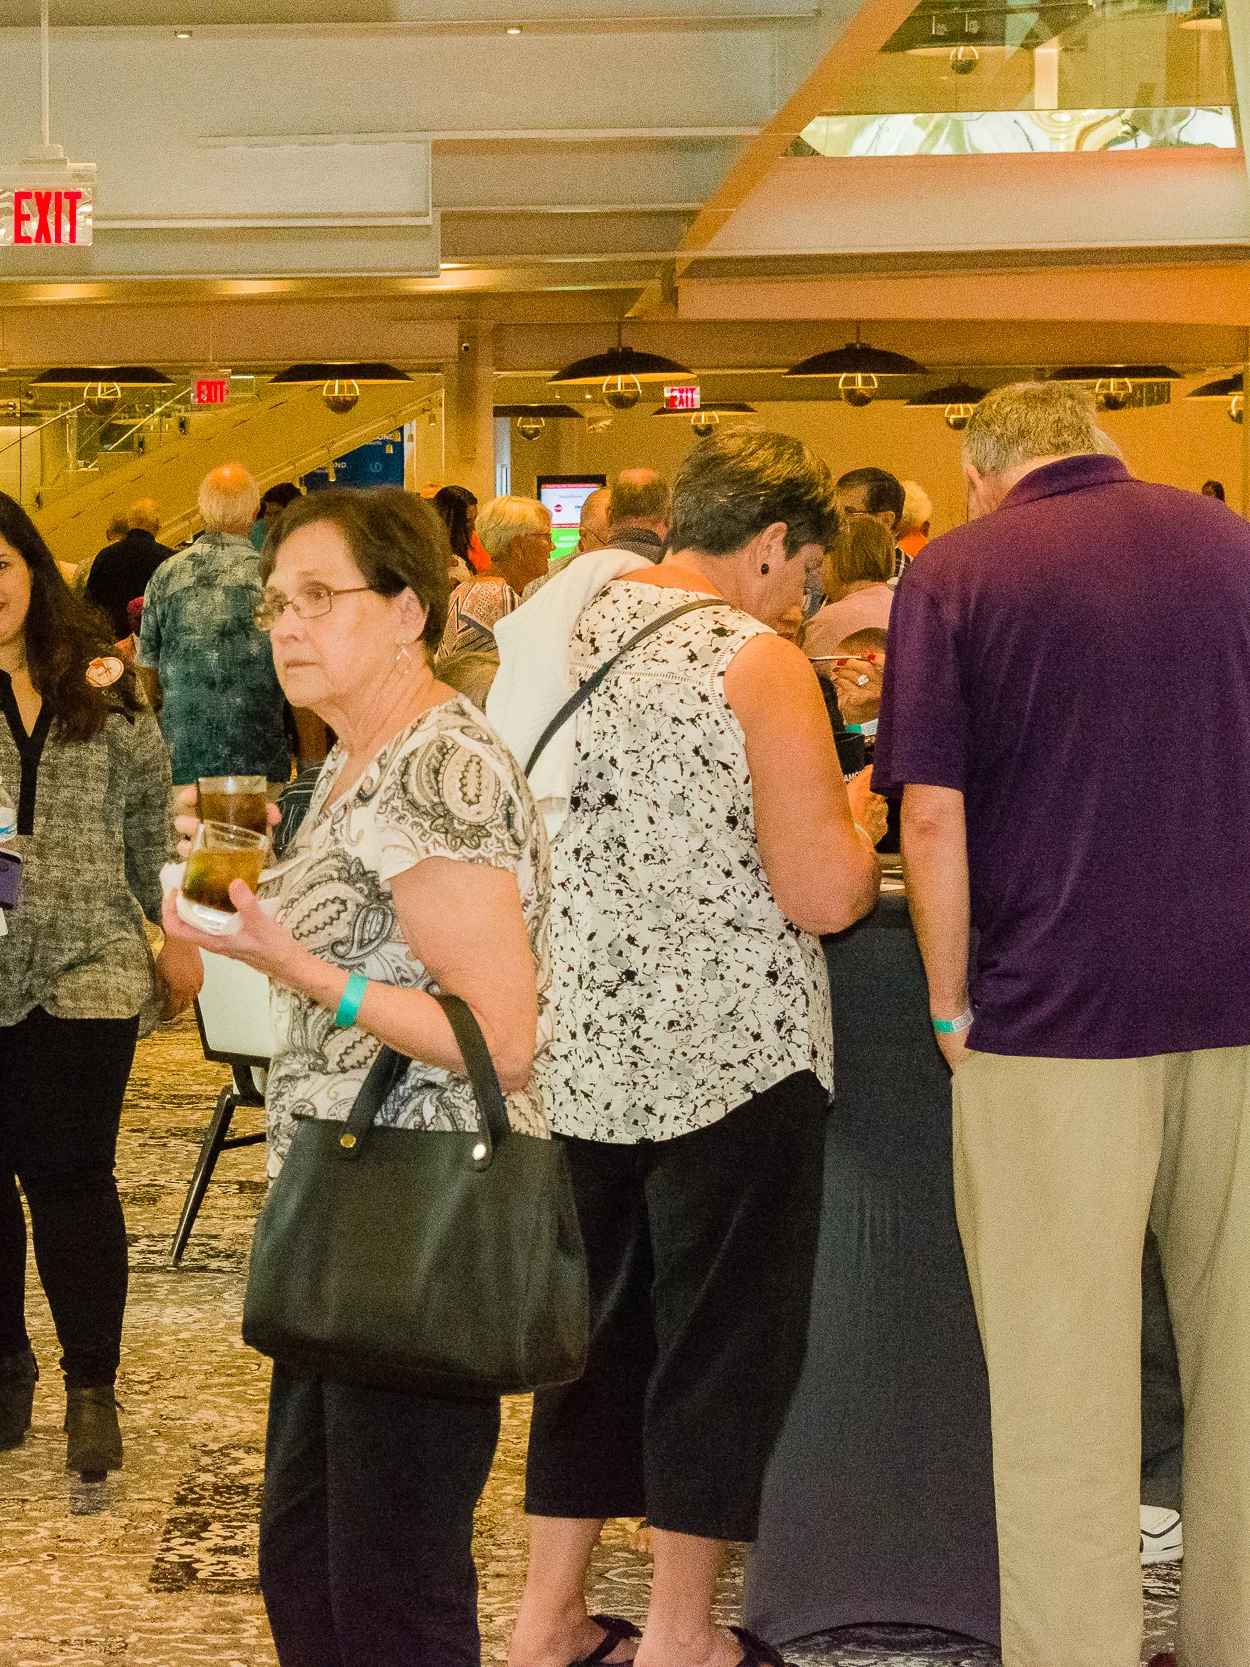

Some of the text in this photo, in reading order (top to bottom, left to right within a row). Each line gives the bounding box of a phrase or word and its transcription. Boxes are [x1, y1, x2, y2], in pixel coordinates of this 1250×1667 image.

[14, 191, 83, 244] EXIT
[197, 380, 226, 403] EXIT
[670, 387, 696, 408] EXIT
